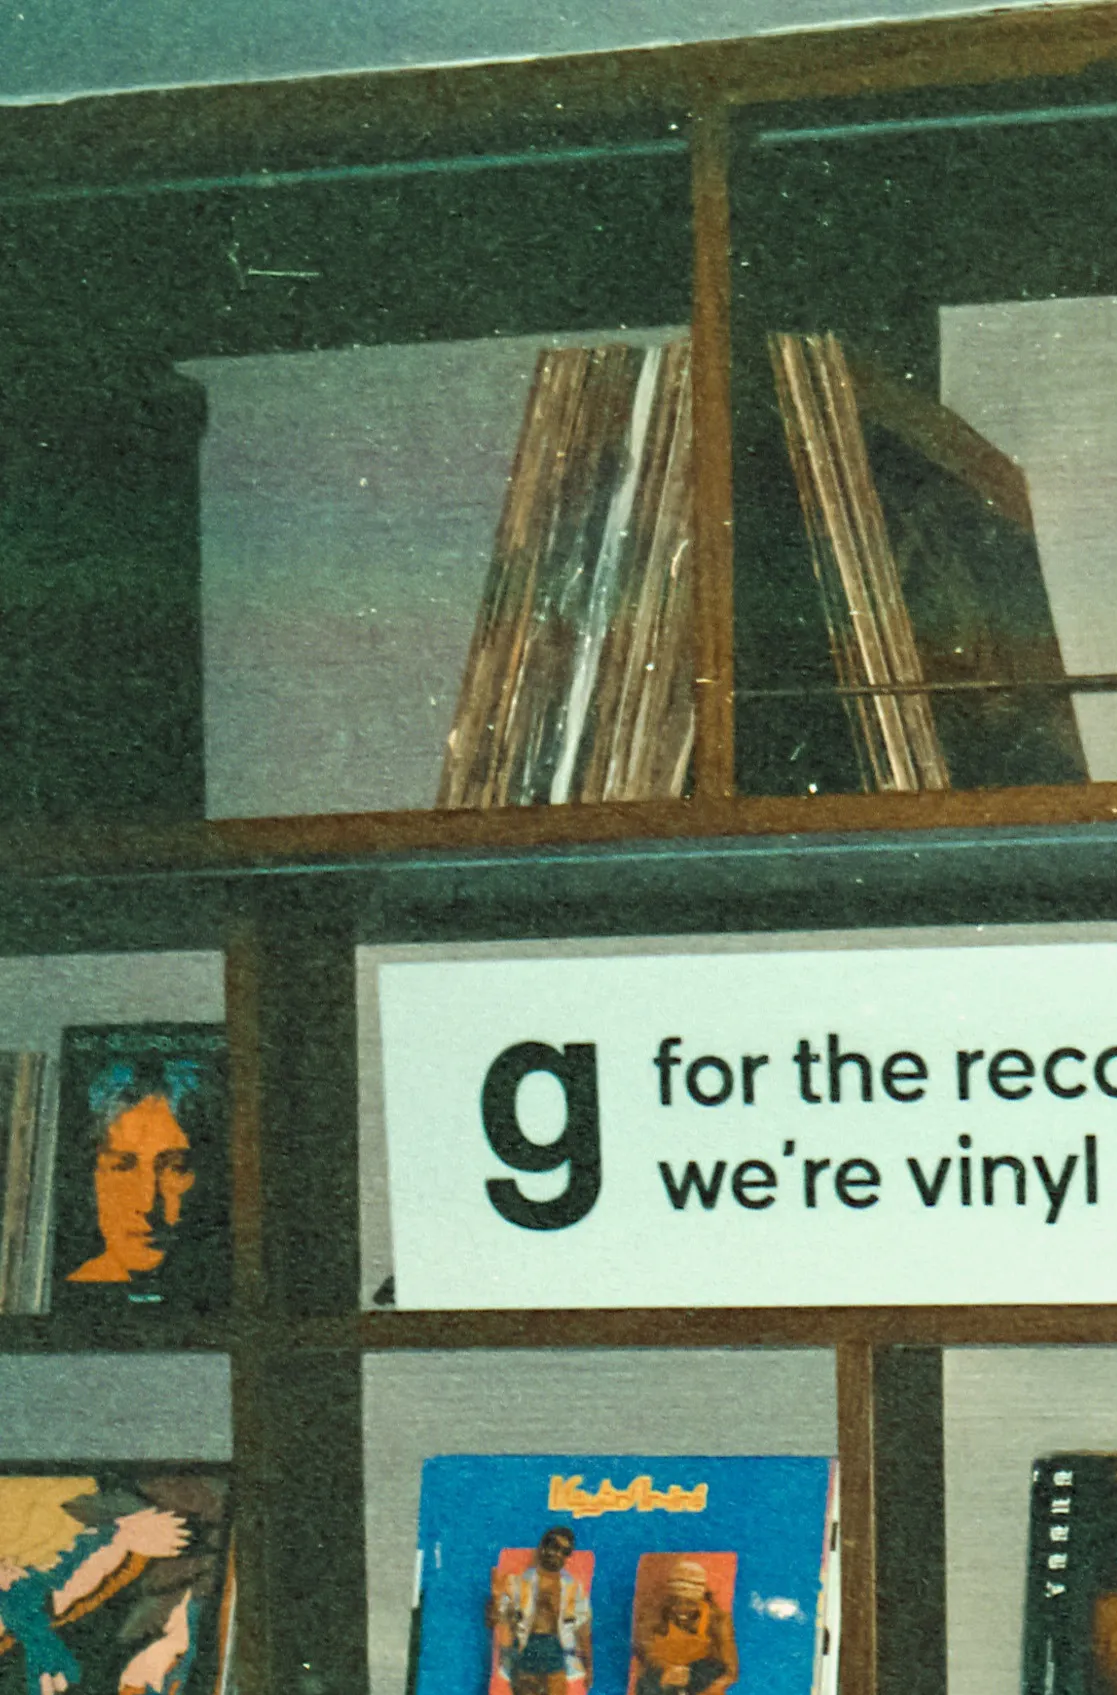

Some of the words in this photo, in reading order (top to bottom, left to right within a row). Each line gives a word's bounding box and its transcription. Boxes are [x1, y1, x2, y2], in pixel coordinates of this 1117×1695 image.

[653, 1037, 769, 1107] for
[792, 1033, 928, 1103] the
[481, 1041, 601, 1231] g
[658, 1140, 881, 1210] we're
[906, 1132, 1098, 1224] vinyl
